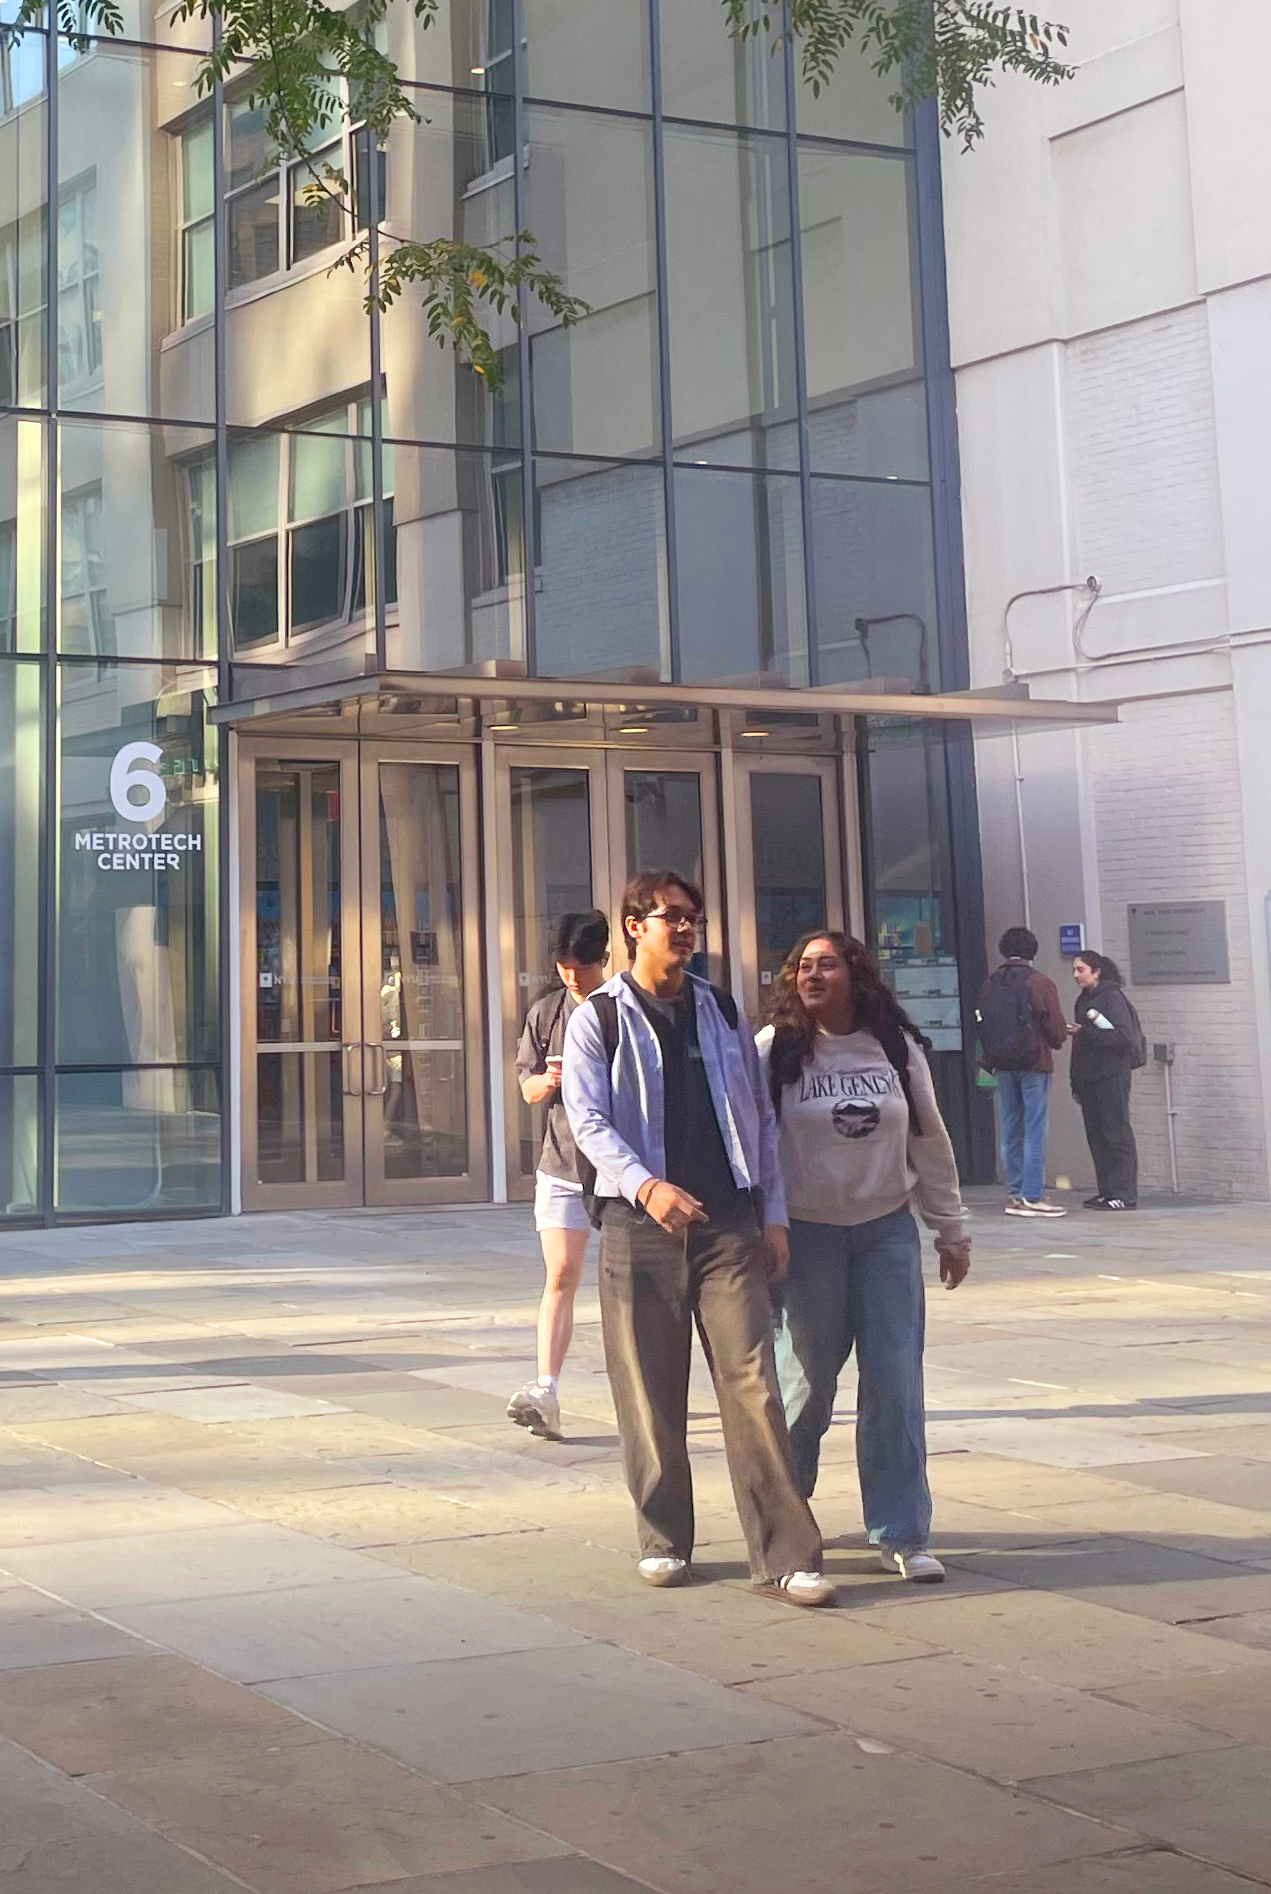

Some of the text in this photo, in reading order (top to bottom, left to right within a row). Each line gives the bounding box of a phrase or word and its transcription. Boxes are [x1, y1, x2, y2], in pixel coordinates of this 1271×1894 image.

[110, 741, 167, 822] 6
[74, 833, 202, 851] METROTECH
[97, 853, 181, 870] CENTER
[798, 1071, 839, 1102] LAKE
